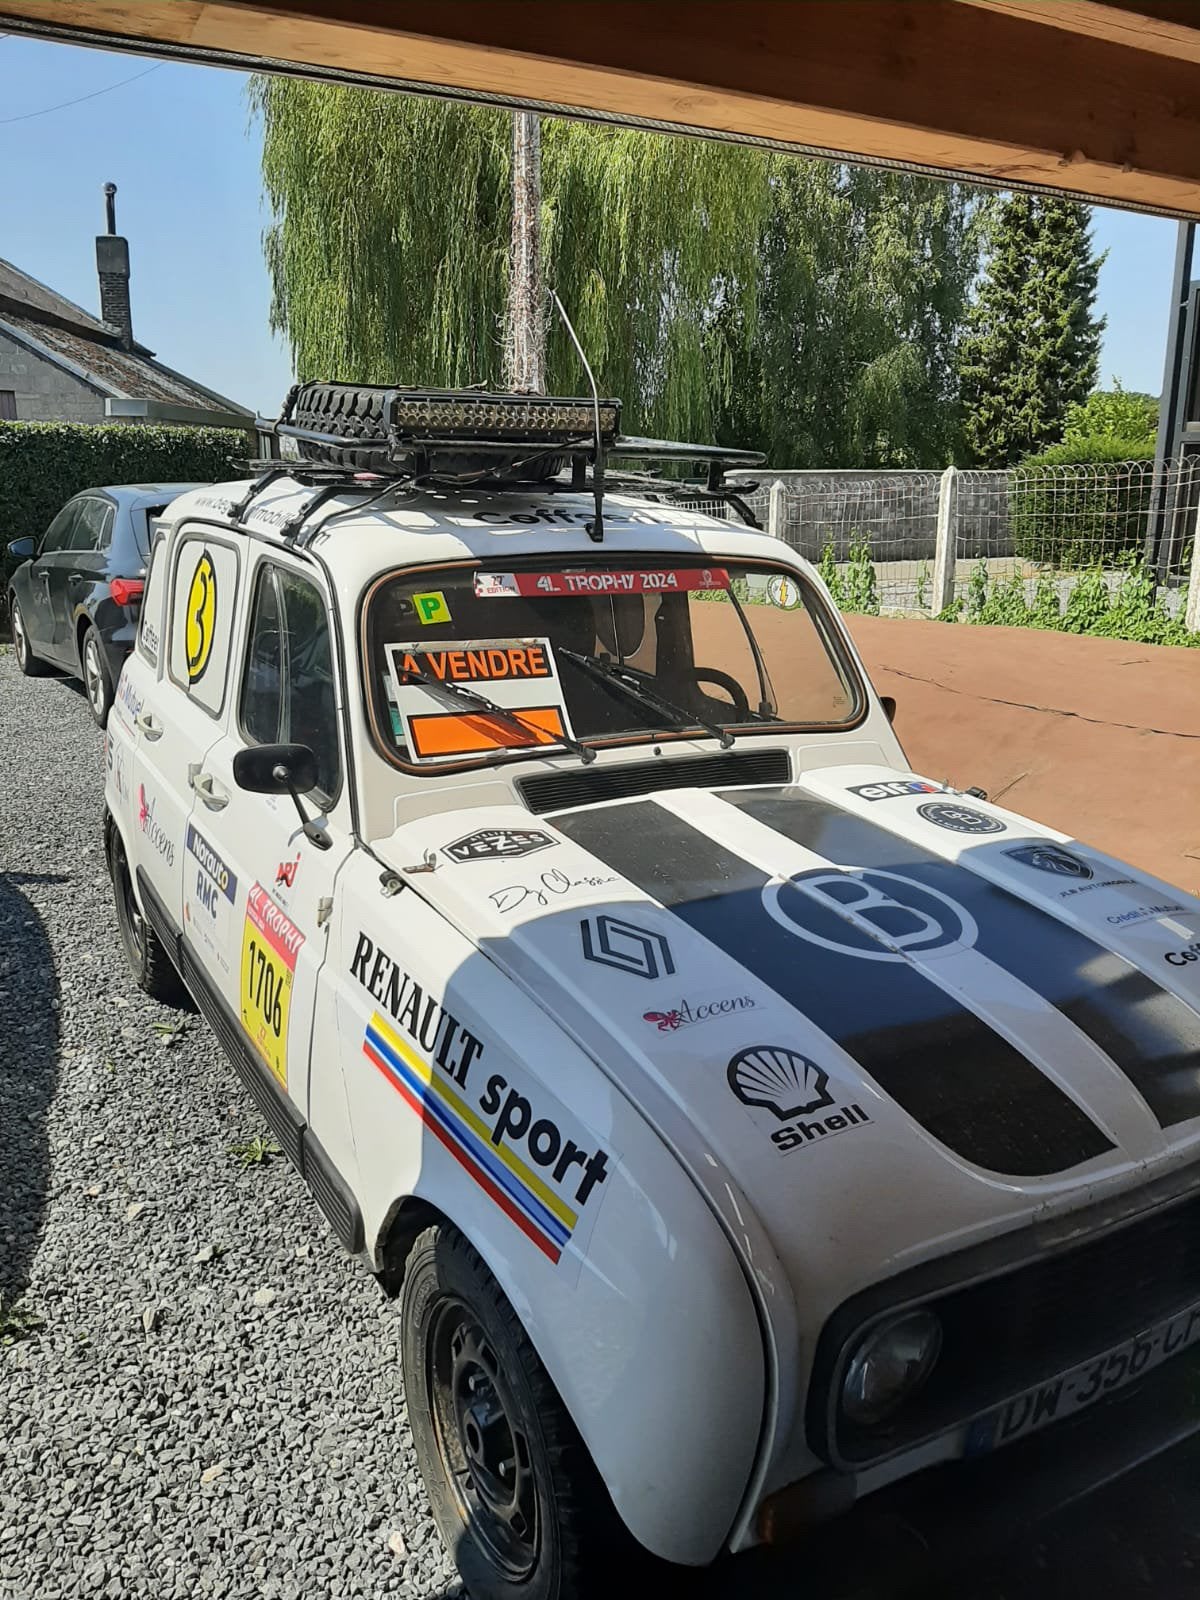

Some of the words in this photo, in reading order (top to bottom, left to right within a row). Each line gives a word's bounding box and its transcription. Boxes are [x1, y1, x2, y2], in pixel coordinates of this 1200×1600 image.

[537, 575, 561, 592] 4L
[564, 573, 634, 591] TROPHY
[640, 572, 678, 588] 2024
[420, 597, 440, 620] P
[426, 648, 548, 681] VENDRE
[859, 783, 911, 798] elf
[193, 833, 228, 891] Norauto
[197, 869, 218, 919] RMC
[250, 885, 264, 911] 4L
[262, 899, 304, 954] TROPHY
[249, 940, 282, 1037] 1706
[680, 998, 756, 1024] Accens
[350, 931, 484, 1091] RENAULT
[479, 1074, 608, 1206] sport
[770, 1103, 870, 1152] Shell
